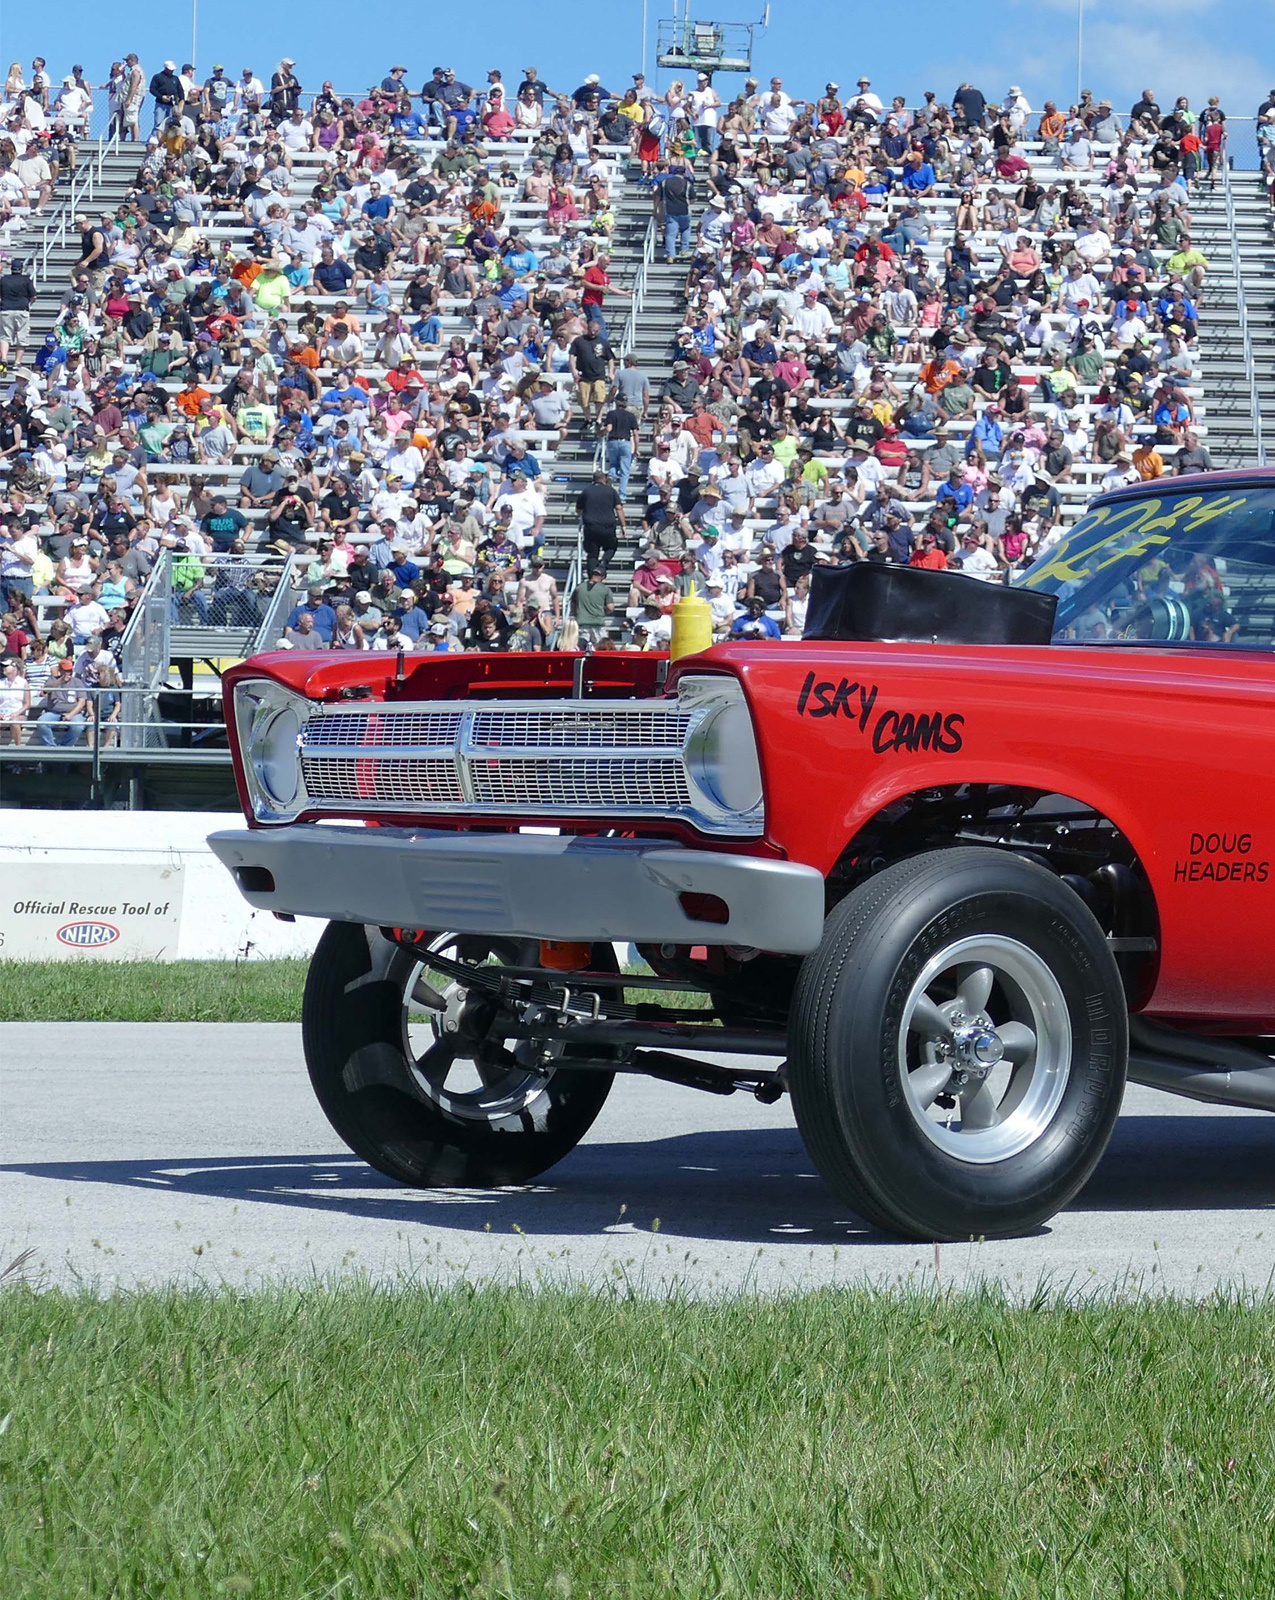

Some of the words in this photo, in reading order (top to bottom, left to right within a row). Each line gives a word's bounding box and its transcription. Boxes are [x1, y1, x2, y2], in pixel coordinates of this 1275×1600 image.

[796, 670, 879, 734] ISKY
[871, 709, 965, 754] CAMS
[1189, 832, 1252, 855] DOUG
[1173, 860, 1270, 883] HEADERS
[13, 900, 65, 915] Official
[68, 902, 117, 916] Rescue
[121, 902, 151, 916] Tool
[153, 902, 170, 916] of
[64, 924, 112, 945] NHRA
